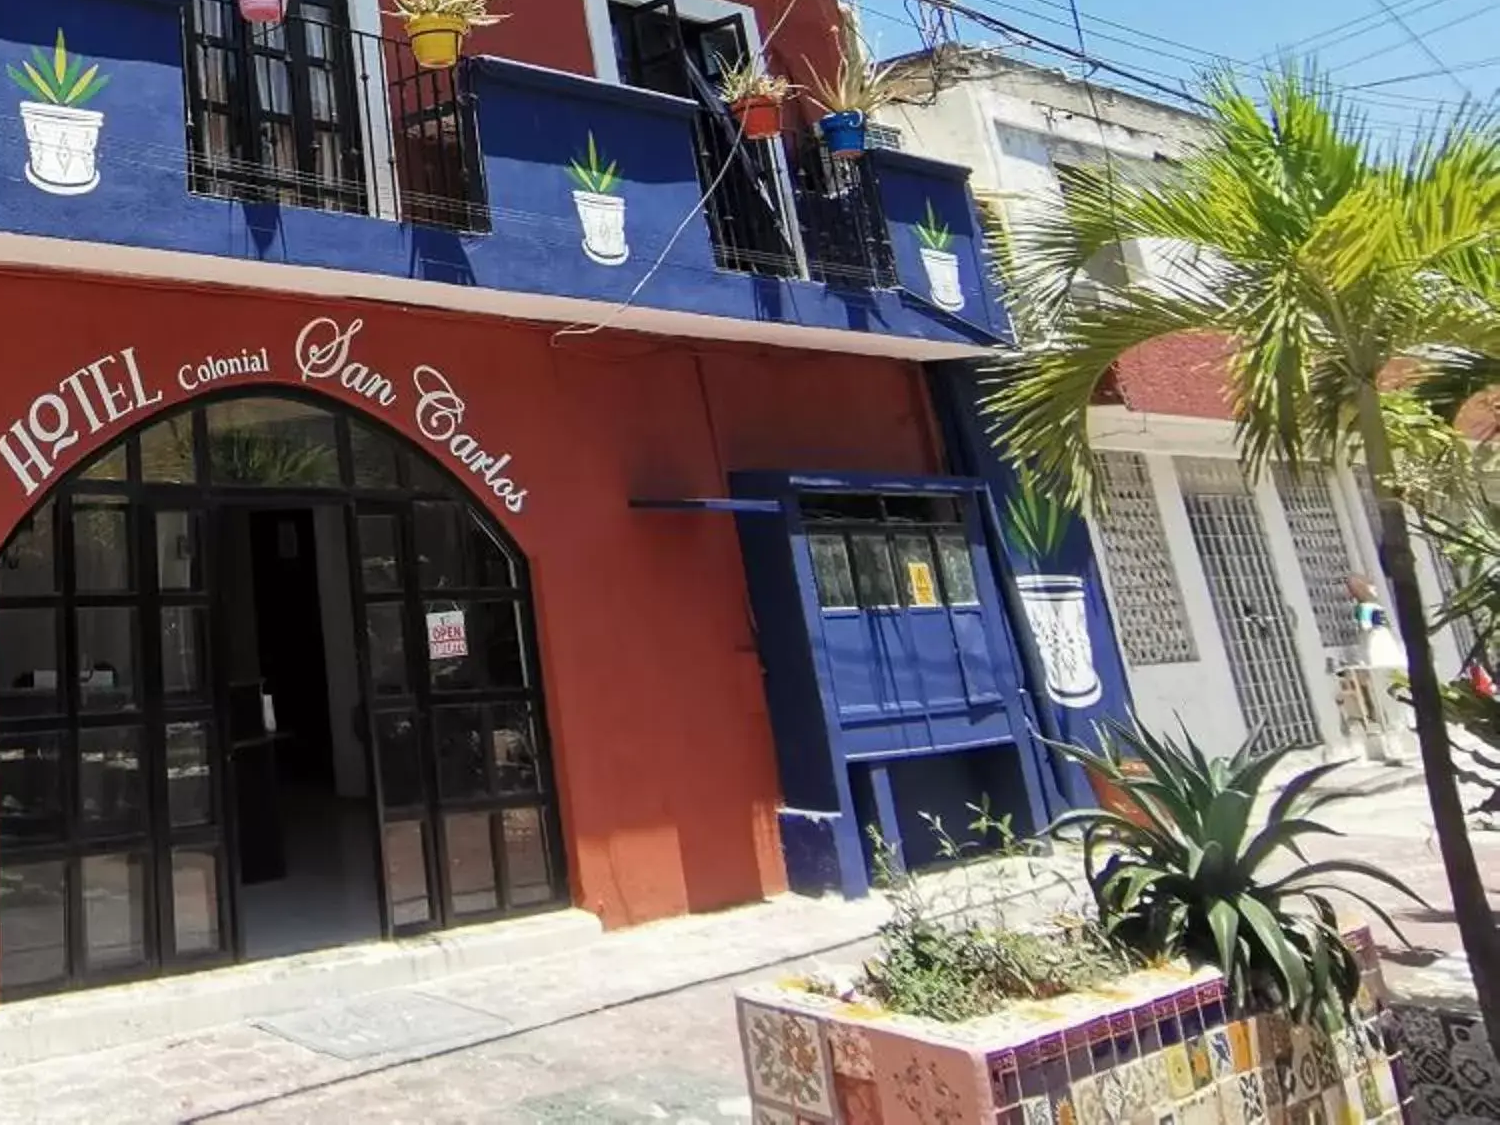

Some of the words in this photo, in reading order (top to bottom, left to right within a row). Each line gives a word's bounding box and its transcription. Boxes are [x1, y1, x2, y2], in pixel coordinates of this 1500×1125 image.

[178, 347, 269, 391] Colonial
[295, 317, 397, 406] San
[412, 364, 528, 513] Carlos
[432, 623, 464, 641] OPEN
